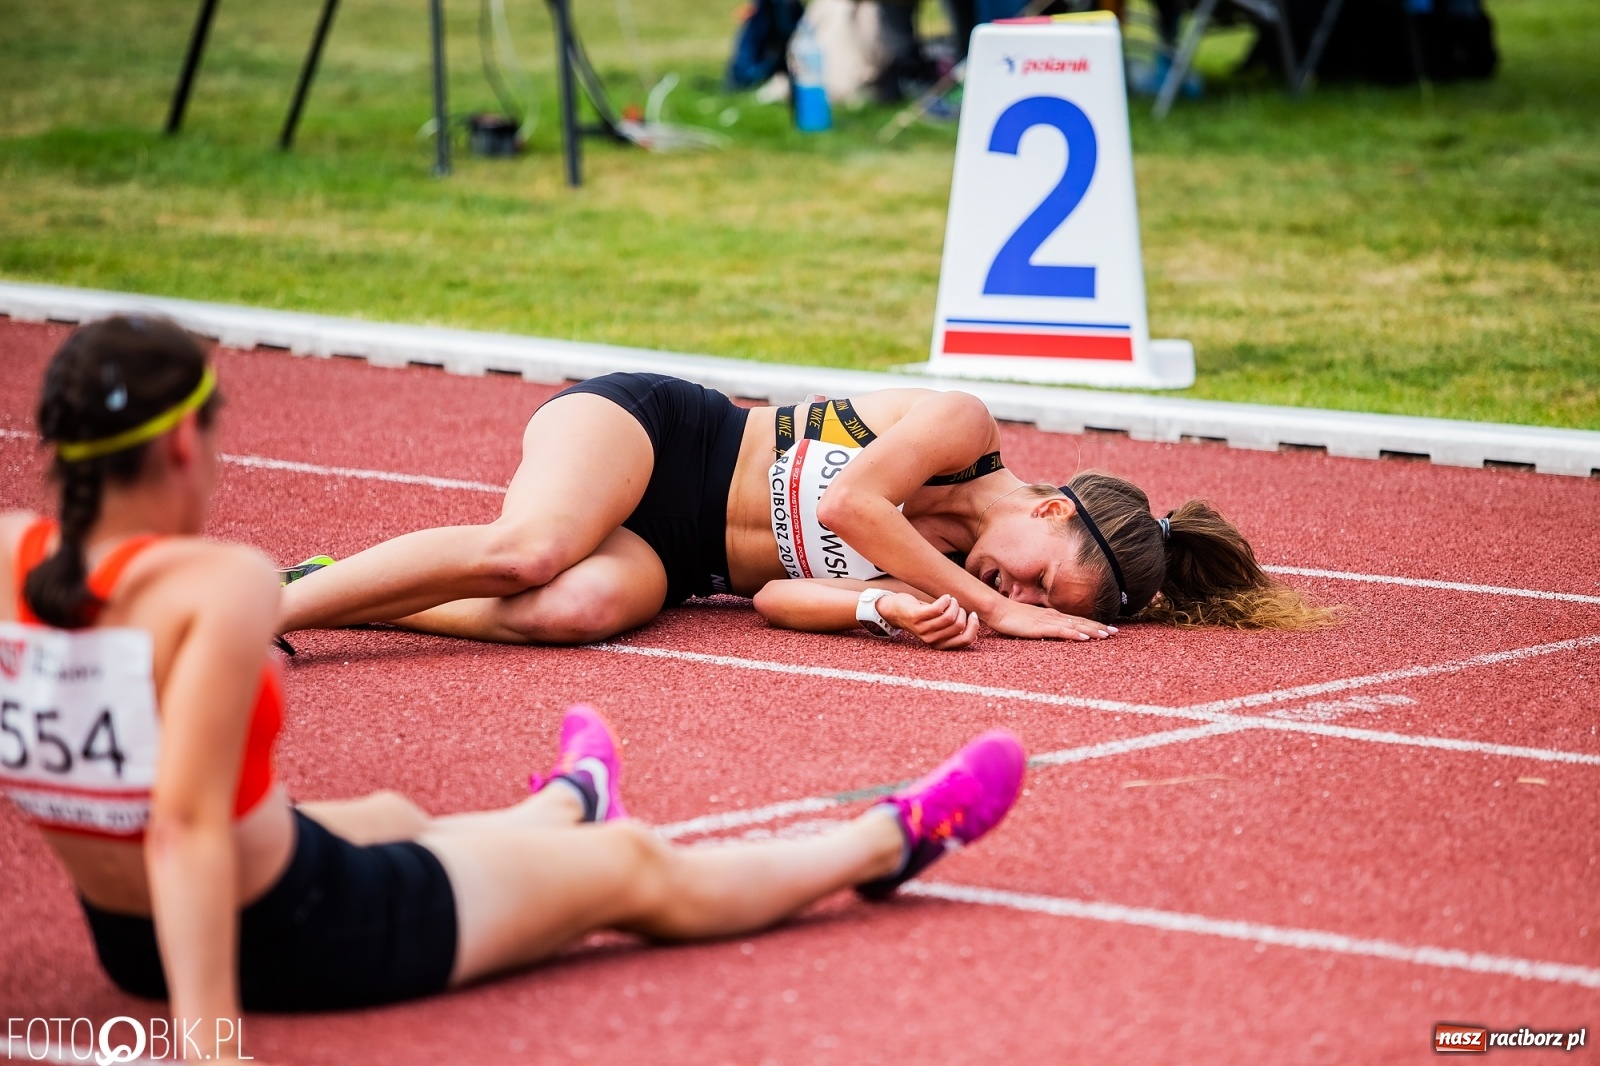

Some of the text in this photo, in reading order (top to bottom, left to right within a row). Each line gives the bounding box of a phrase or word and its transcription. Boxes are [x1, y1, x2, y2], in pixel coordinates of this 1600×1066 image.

[982, 96, 1097, 298] 2
[778, 415, 791, 438] NIKE
[809, 406, 823, 429] NIKE
[844, 416, 869, 439] NIKE
[791, 467, 800, 489] PZLA
[772, 456, 791, 541] RACIBÓRZ
[791, 490, 802, 545] MISTRZOSTWA
[779, 544, 801, 578] 2019
[797, 546, 808, 570] POLSKI
